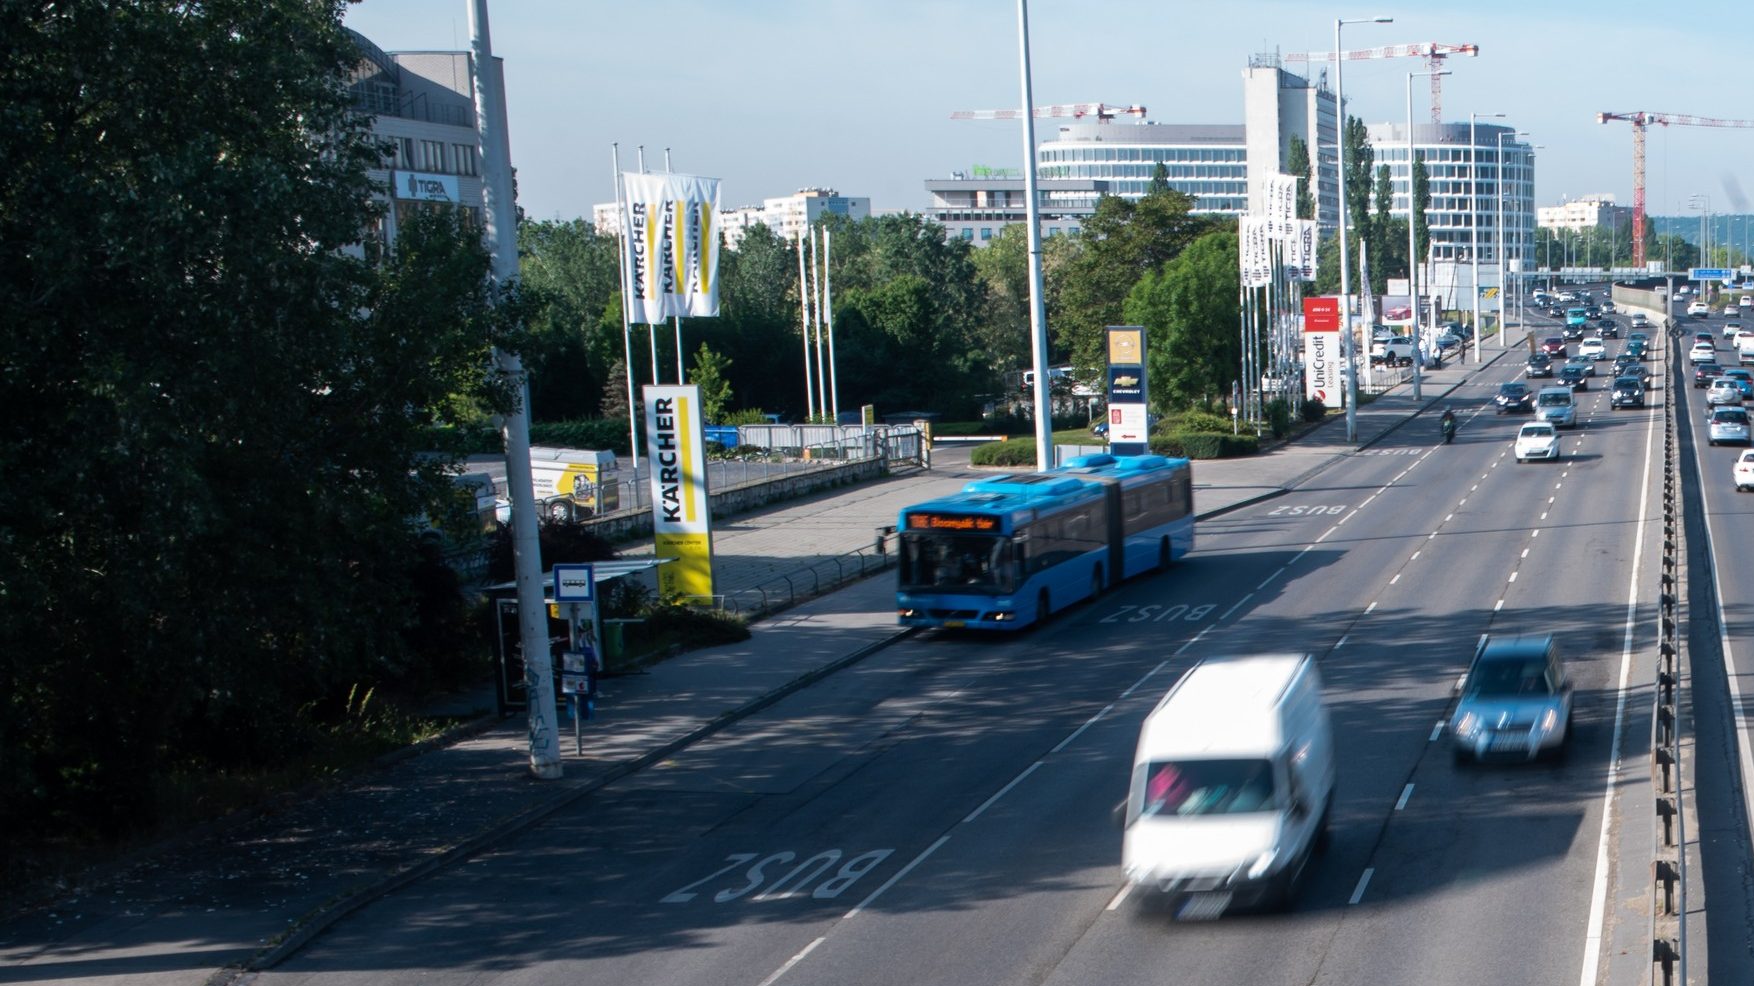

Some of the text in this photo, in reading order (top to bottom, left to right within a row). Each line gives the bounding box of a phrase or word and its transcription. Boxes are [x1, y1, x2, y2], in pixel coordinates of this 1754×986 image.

[418, 179, 447, 194] TIGRA
[1303, 226, 1312, 264] TIGRA
[1313, 336, 1325, 388] UniCredit
[656, 397, 681, 522] KÄRCHER
[1267, 505, 1350, 516] BUSZ
[1099, 604, 1217, 623] BUSZ
[658, 849, 896, 903] BUSZ
